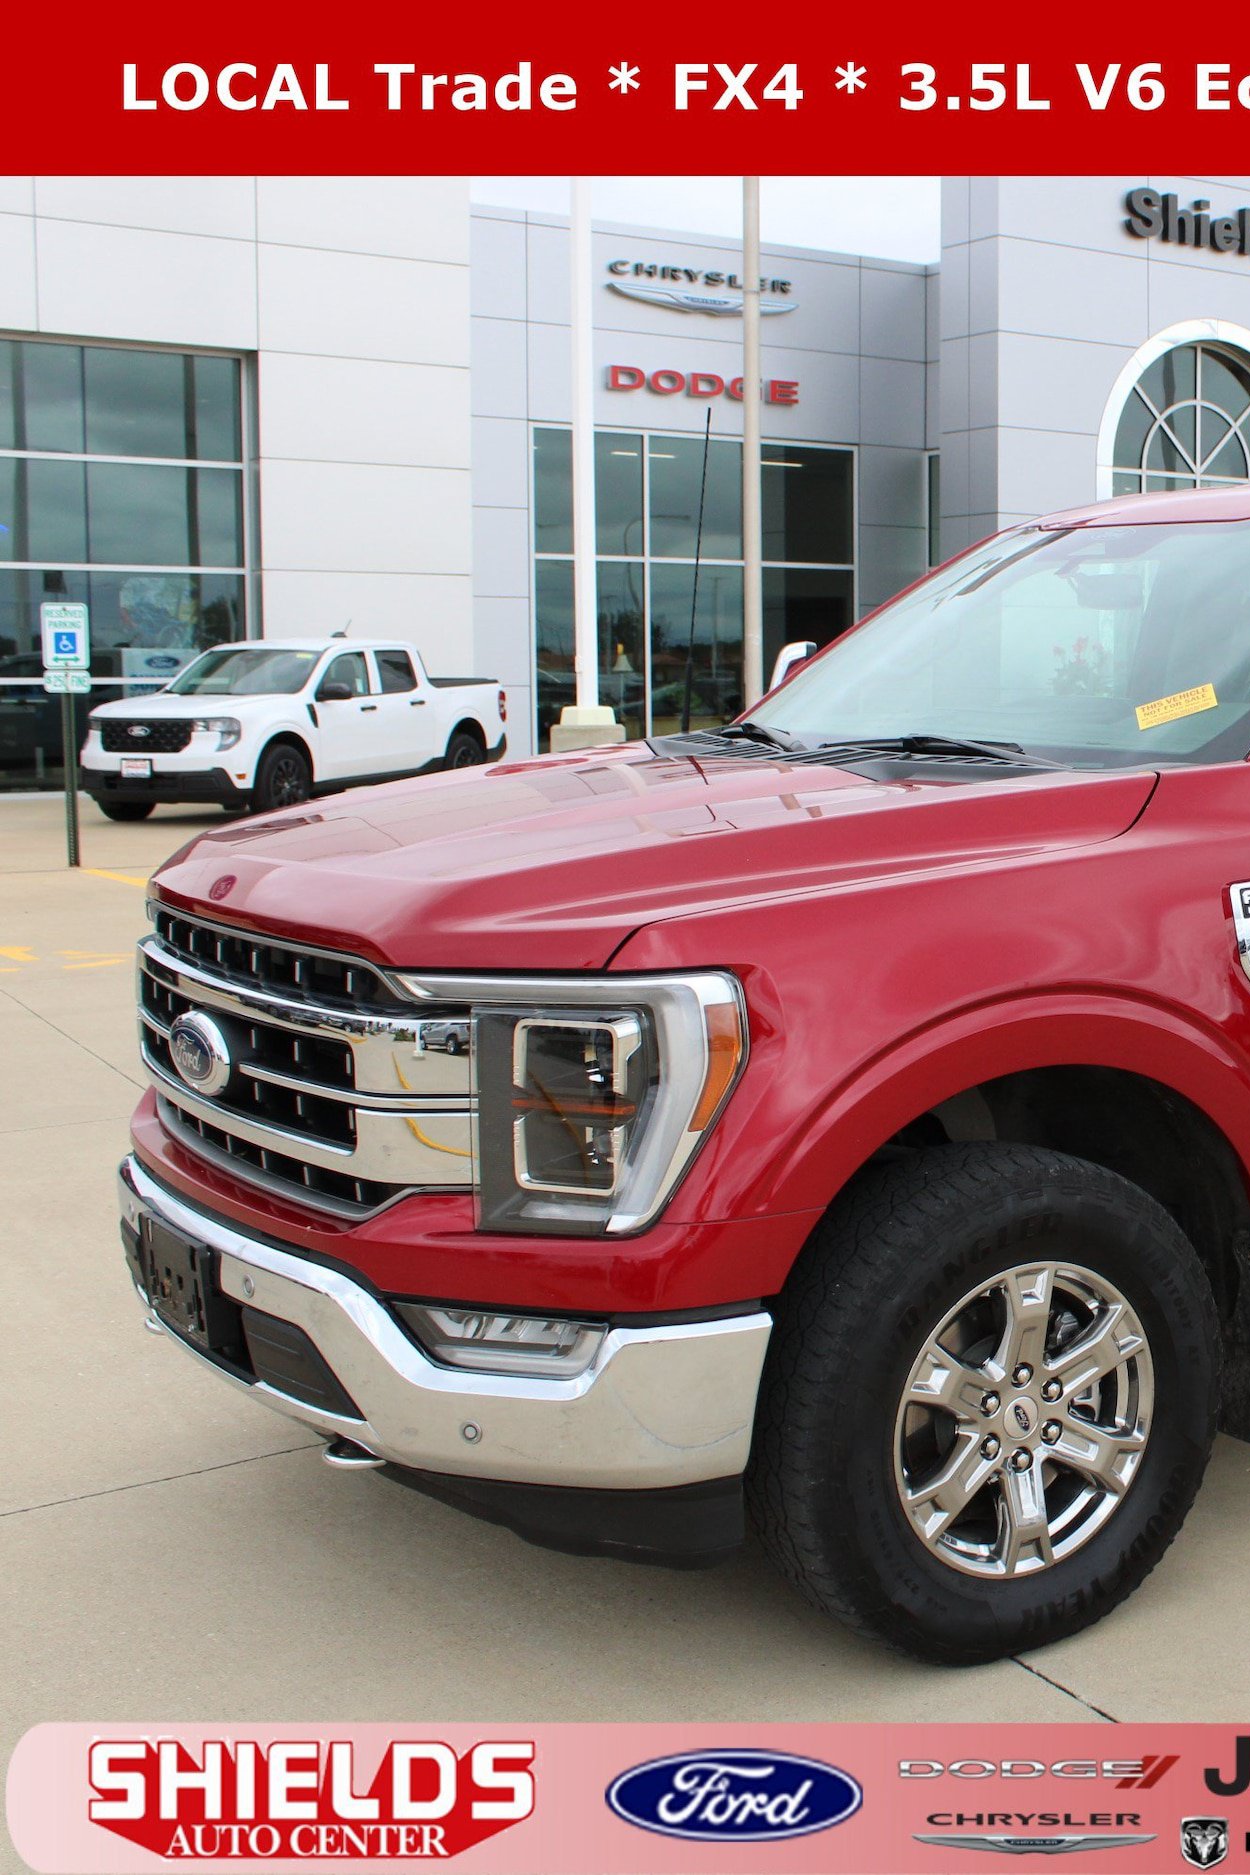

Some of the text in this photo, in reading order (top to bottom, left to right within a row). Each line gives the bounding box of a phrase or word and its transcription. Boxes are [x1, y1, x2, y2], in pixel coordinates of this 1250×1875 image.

[1141, 701, 1164, 712] THIS
[1165, 687, 1208, 704] VEHICLE
[1144, 708, 1160, 717] NOT
[176, 1031, 202, 1072] Ford
